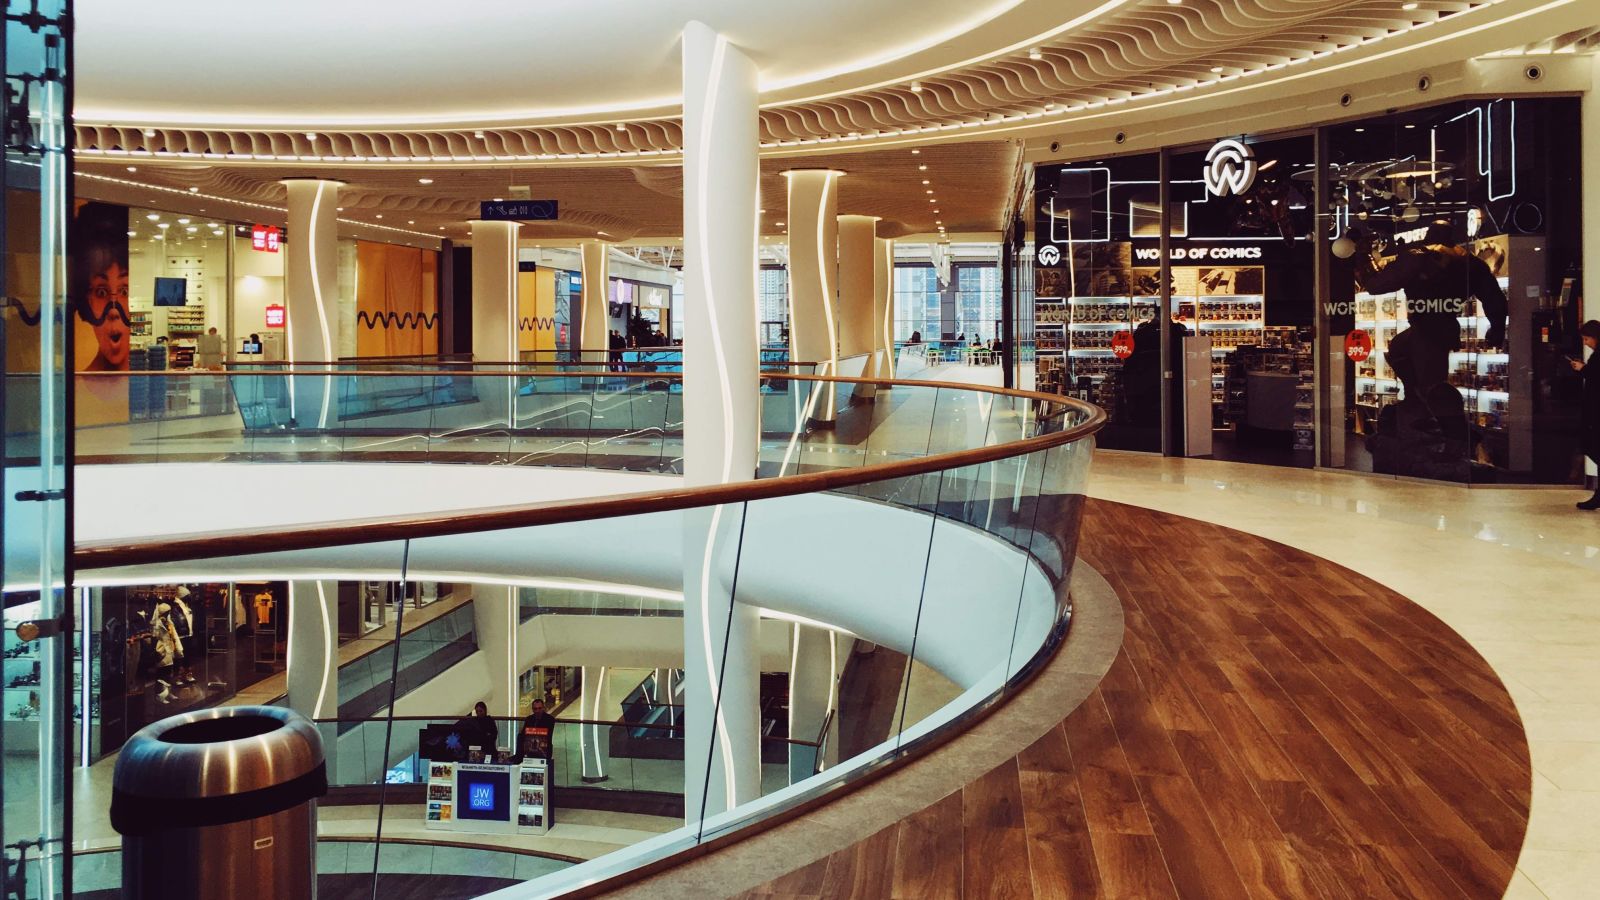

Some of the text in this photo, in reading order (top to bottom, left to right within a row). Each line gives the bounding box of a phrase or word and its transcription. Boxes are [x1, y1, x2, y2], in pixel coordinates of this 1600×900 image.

[1135, 247, 1262, 260] WOLD OF COMICS
[1323, 298, 1462, 316] WORLD OF COMICS
[1039, 307, 1156, 321] WORLD OF COMICS
[1114, 345, 1128, 354] 399
[1347, 346, 1364, 356] 399
[474, 788, 490, 799] JW
